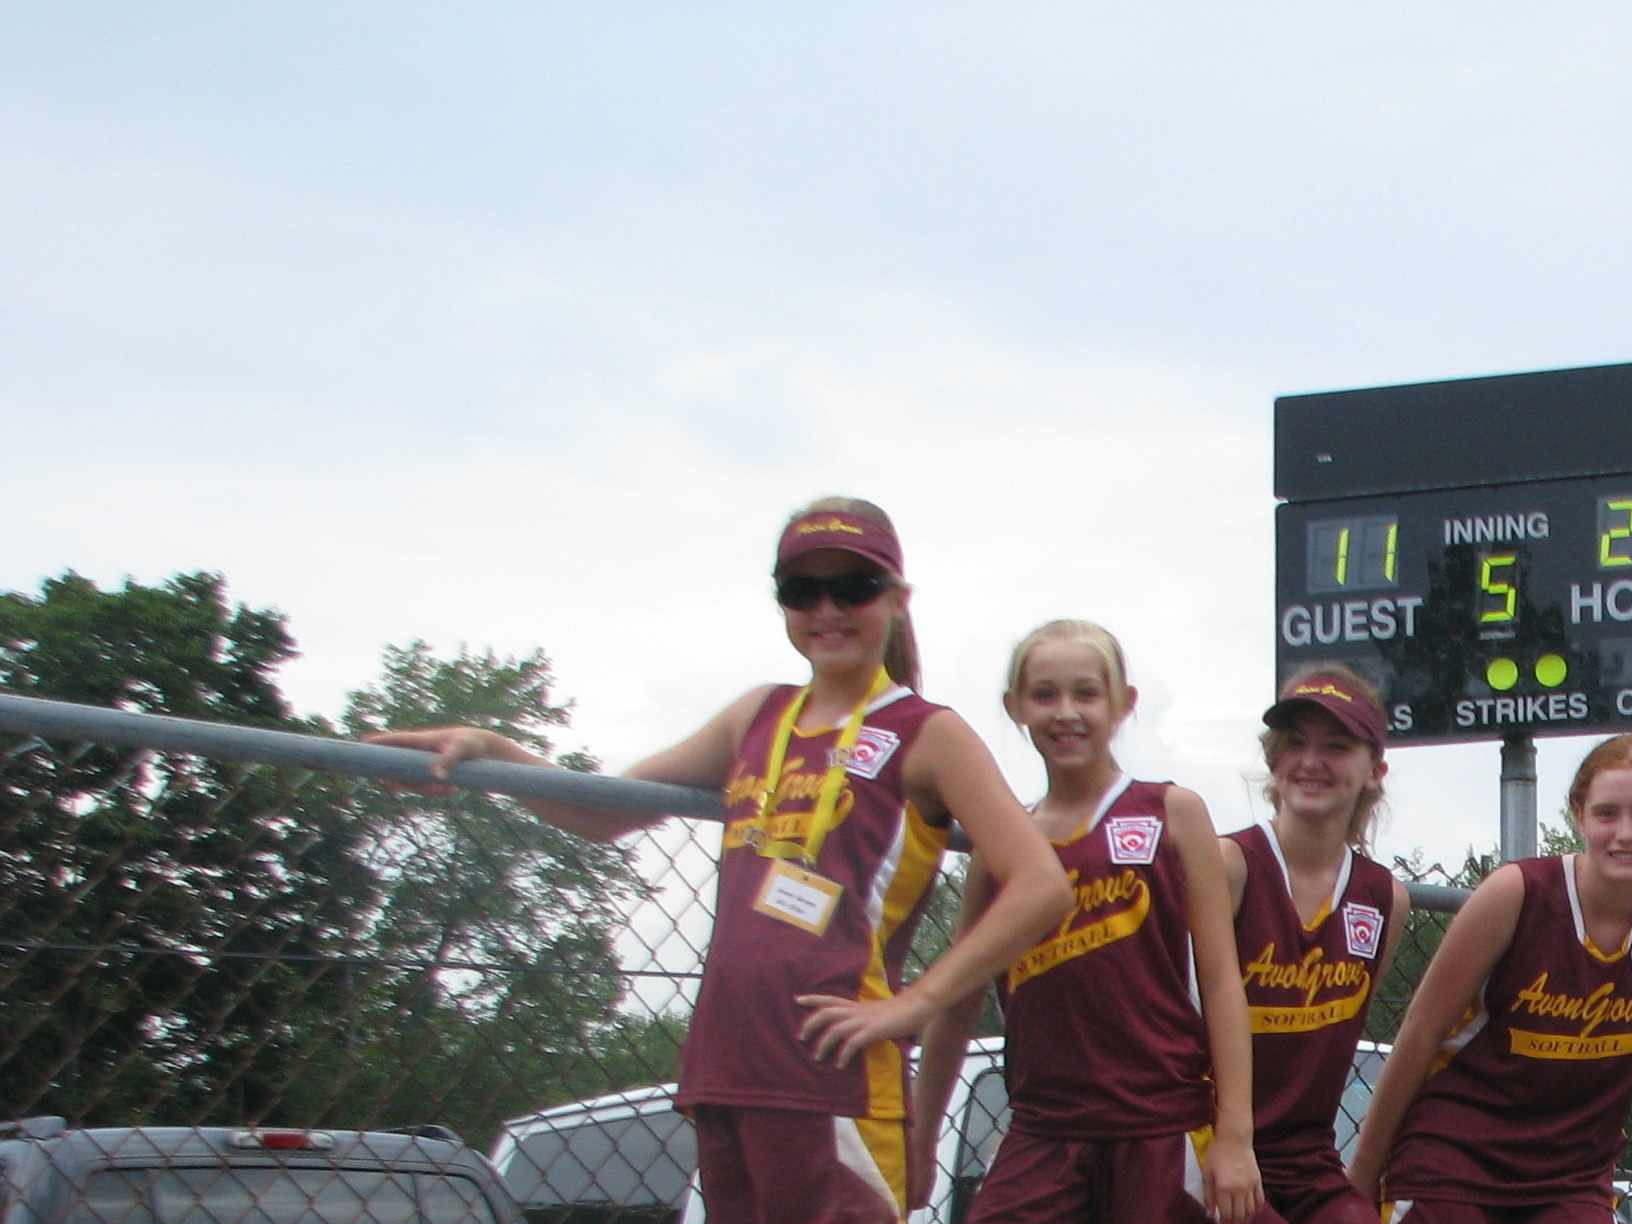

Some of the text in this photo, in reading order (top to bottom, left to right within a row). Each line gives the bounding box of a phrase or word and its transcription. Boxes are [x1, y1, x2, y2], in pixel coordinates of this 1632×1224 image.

[1444, 512, 1550, 545] INNING
[1335, 523, 1398, 586] 11
[1480, 555, 1517, 622] 5
[1282, 597, 1423, 647] GUEST
[1455, 692, 1588, 728] STRIKES
